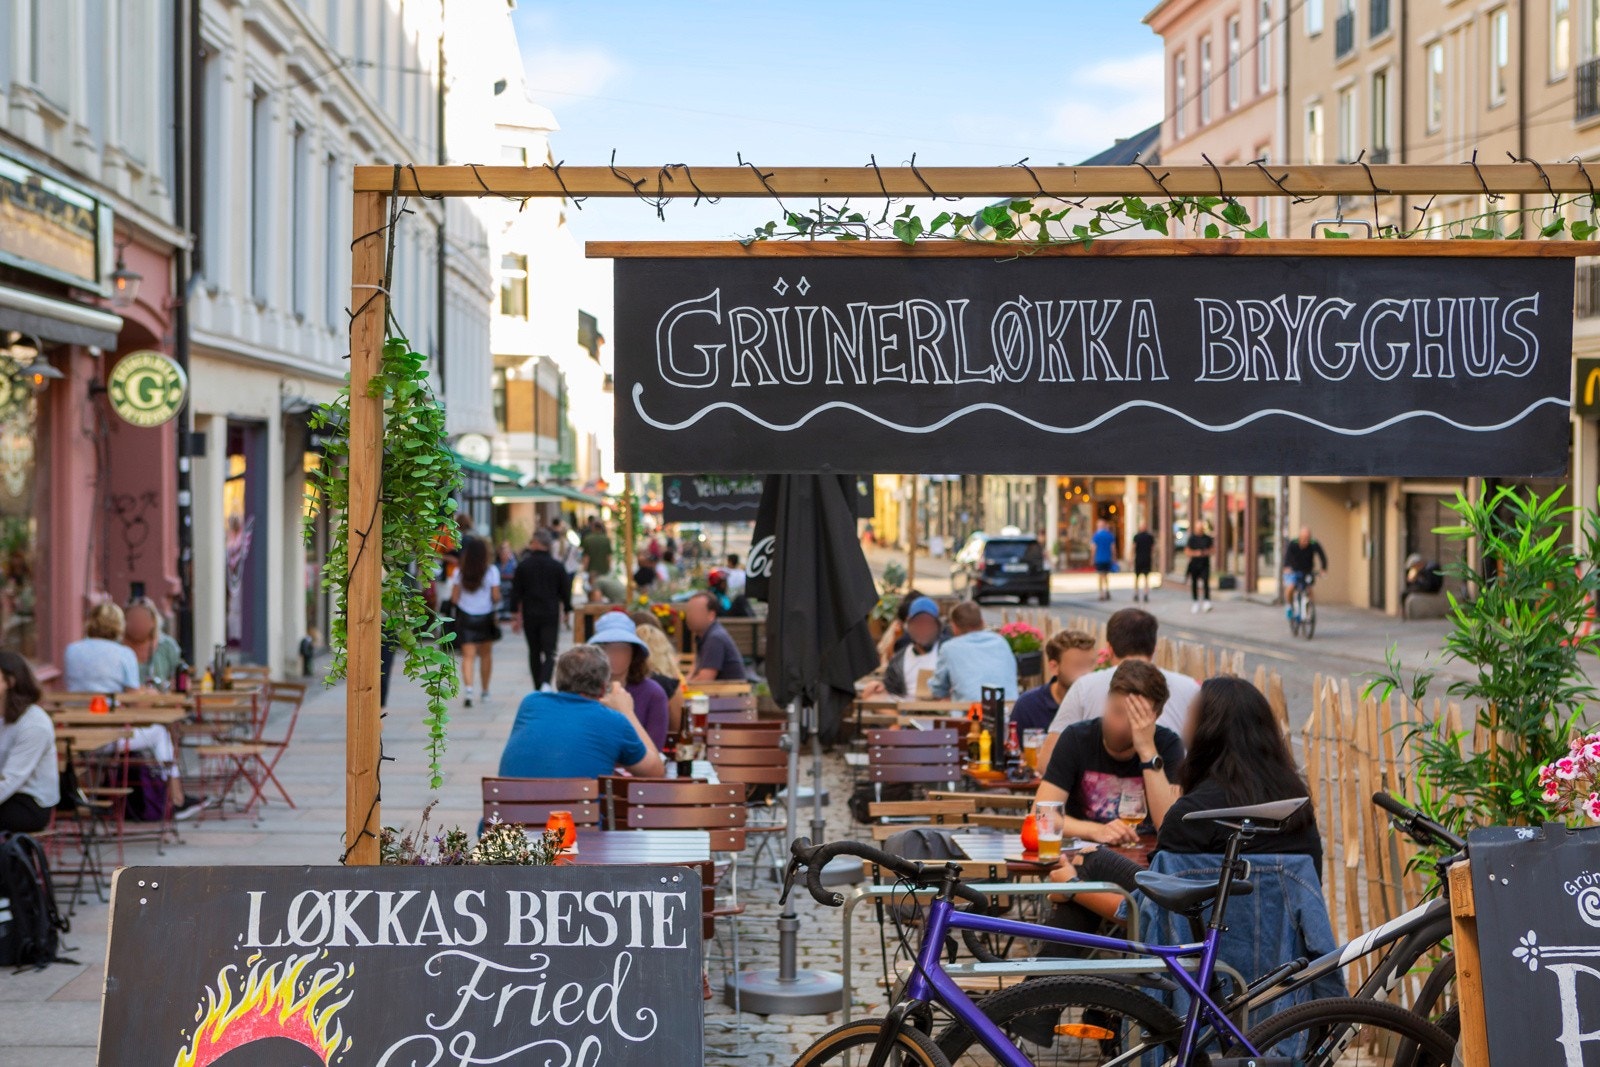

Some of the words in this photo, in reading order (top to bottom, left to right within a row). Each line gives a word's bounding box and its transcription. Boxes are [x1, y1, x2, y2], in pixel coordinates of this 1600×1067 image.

[656, 276, 1169, 388] GRÜNERLØKKA
[1194, 292, 1540, 382] BRYGGHUS
[125, 370, 165, 410] G
[242, 889, 488, 949] LØKKAS
[505, 889, 688, 949] BESTE
[424, 950, 658, 1042] Fried
